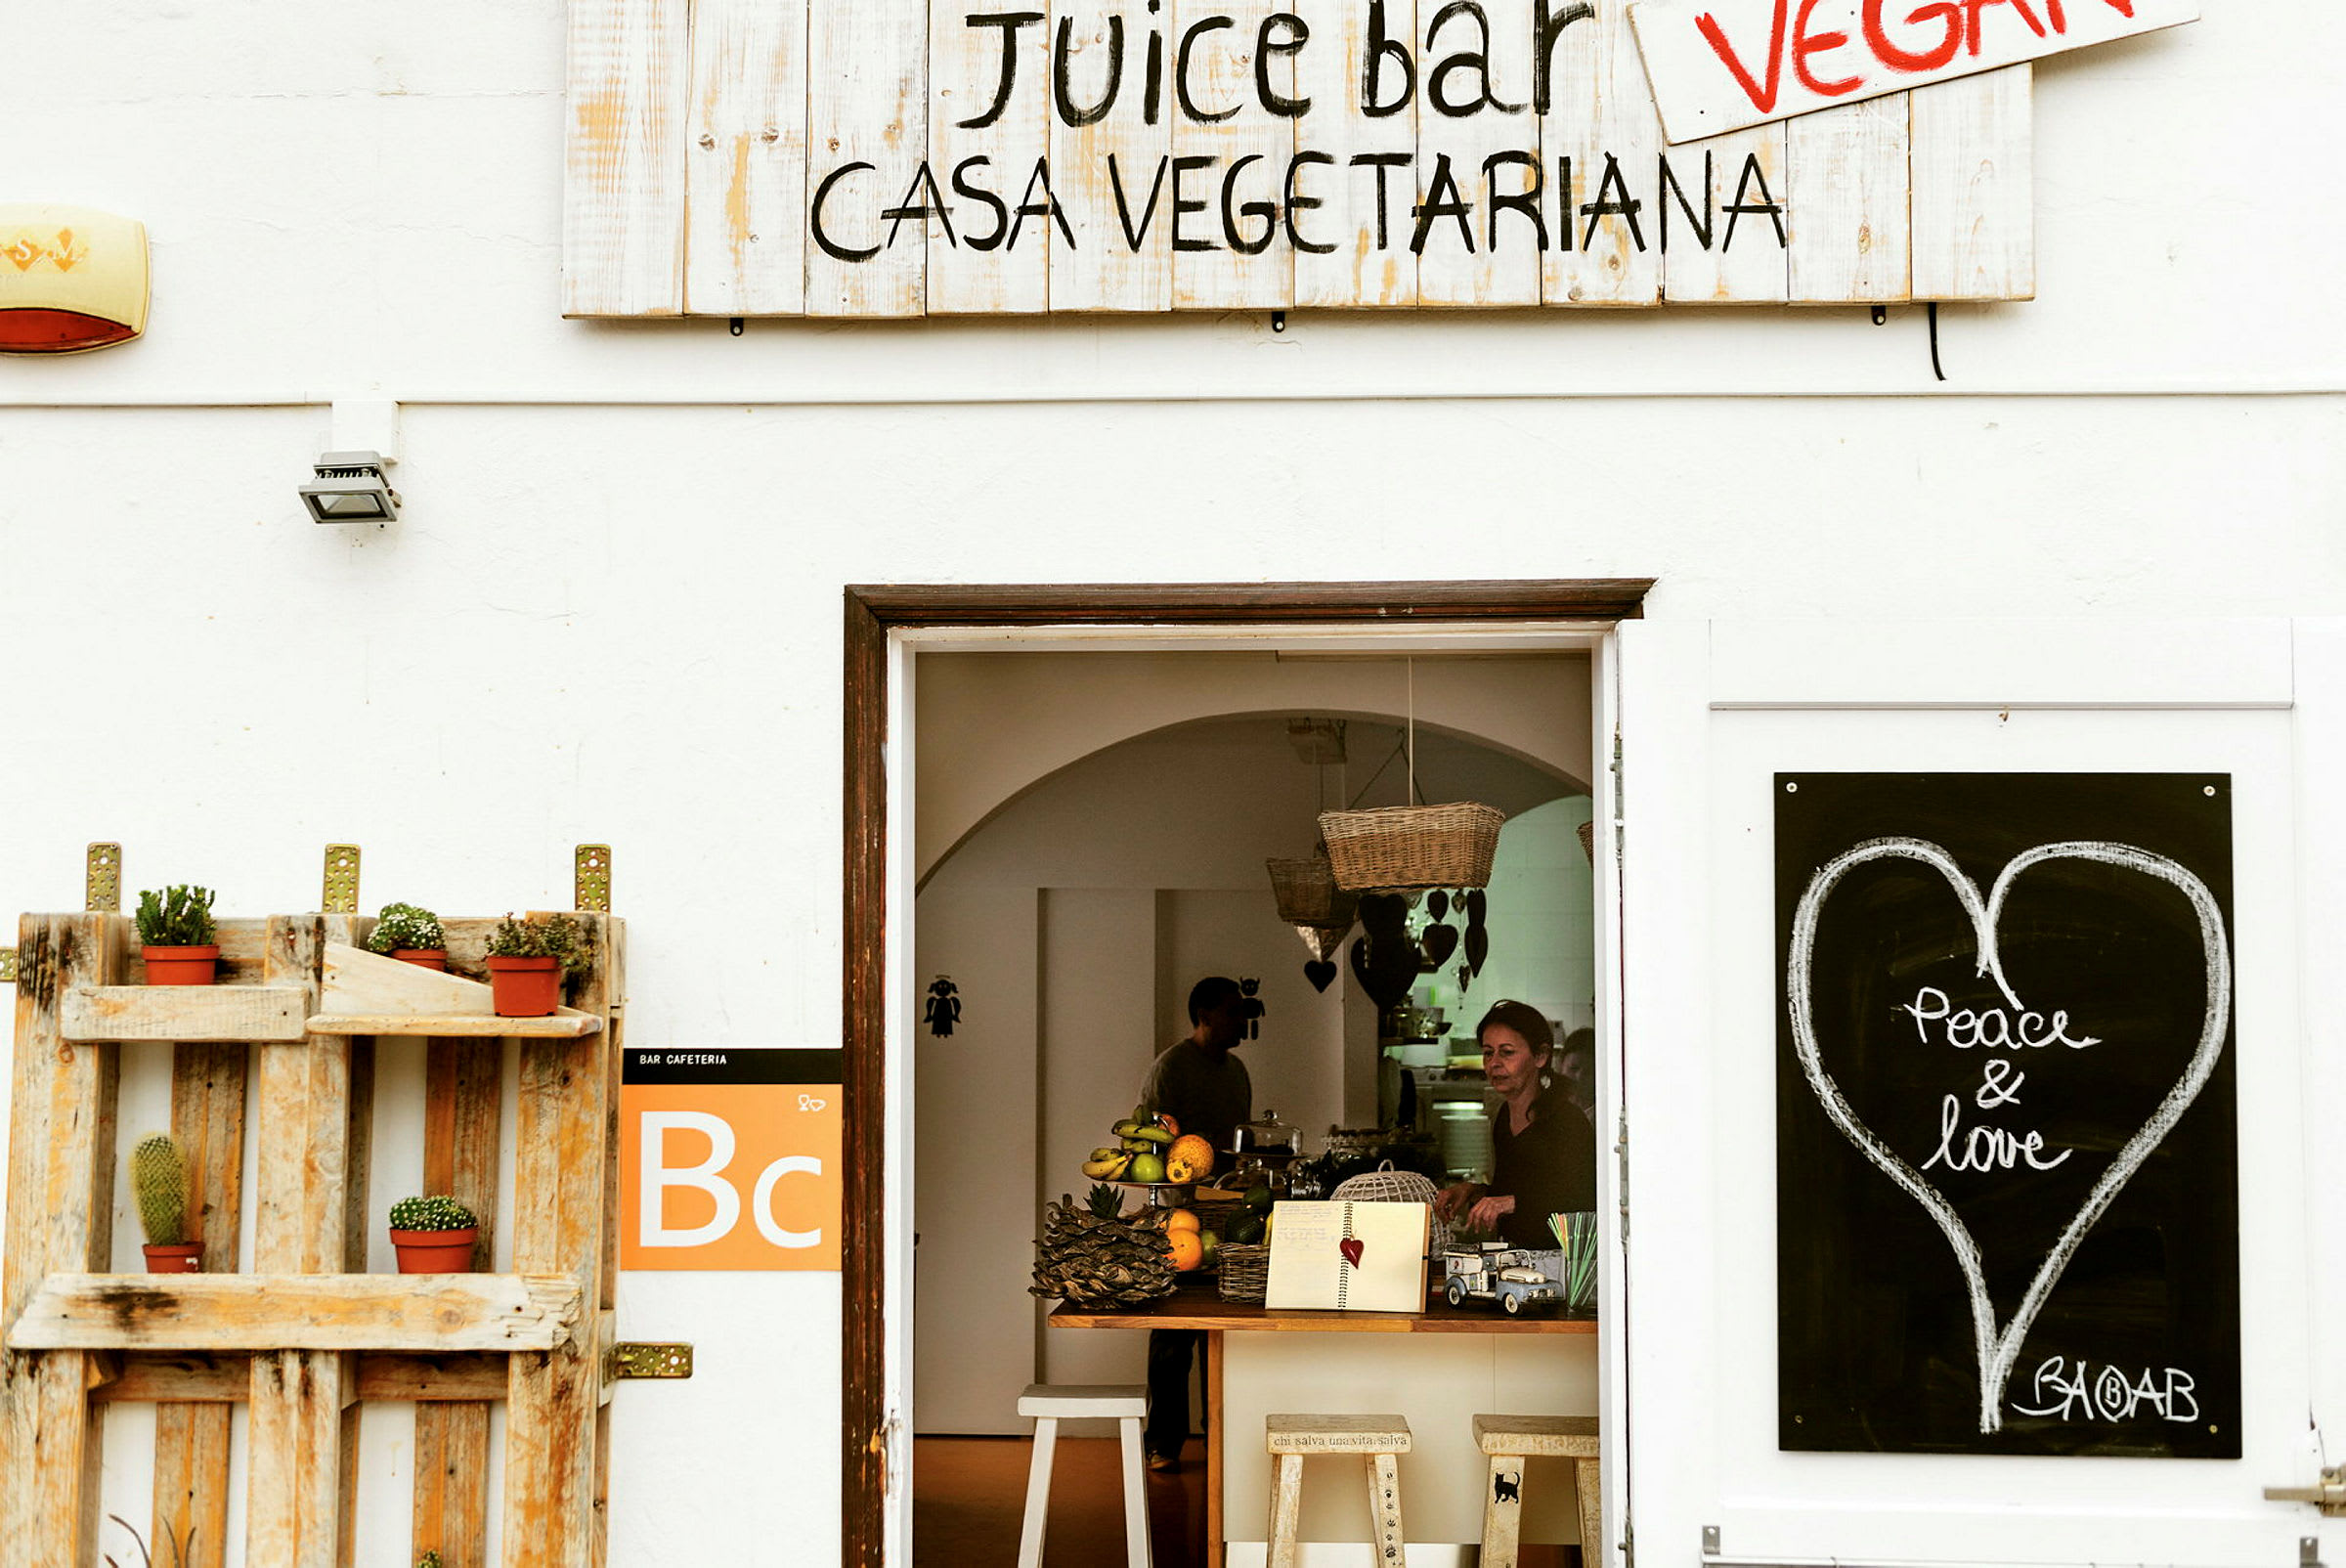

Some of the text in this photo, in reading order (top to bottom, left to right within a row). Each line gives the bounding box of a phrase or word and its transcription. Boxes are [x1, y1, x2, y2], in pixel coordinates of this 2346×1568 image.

[1360, 0, 1595, 119] bar
[1694, 0, 2135, 114] VEG
[810, 150, 1786, 263] CASA VEGETARIANA
[1902, 986, 2104, 1050] Peace
[639, 1054, 727, 1065] BAR CAFETERIA
[1976, 1059, 2025, 1110] &
[1921, 1093, 2073, 1173] love
[639, 1111, 822, 1248] Bc
[1274, 1435, 1290, 1446] chi
[1295, 1435, 1325, 1446] salva
[1377, 1434, 1408, 1446] salva
